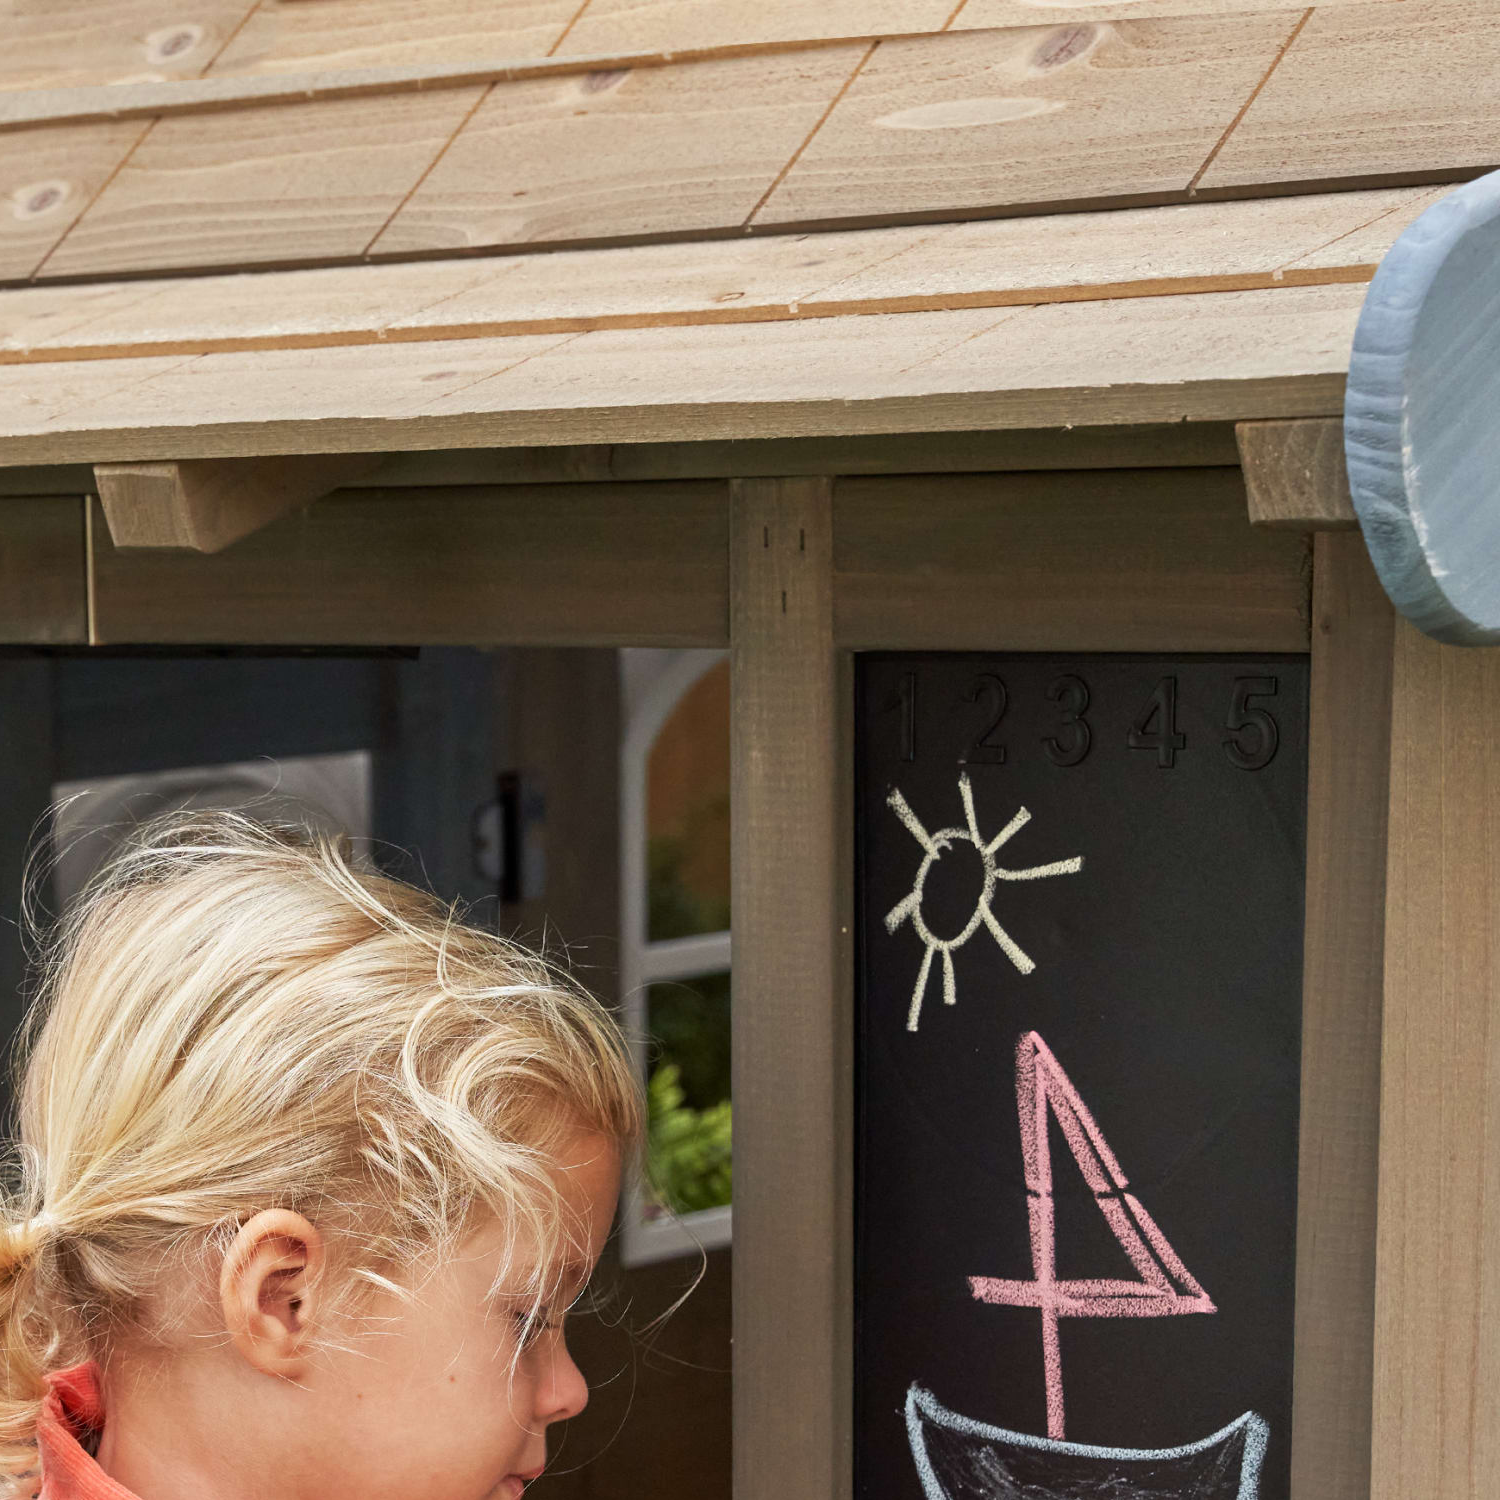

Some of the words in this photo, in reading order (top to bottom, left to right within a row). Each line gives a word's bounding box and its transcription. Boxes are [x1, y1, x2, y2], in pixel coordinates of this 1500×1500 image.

[882, 671, 916, 763] 1
[957, 672, 1008, 765] 2
[1042, 673, 1091, 767] 3
[1127, 675, 1186, 769] 4
[1221, 676, 1280, 771] 5
